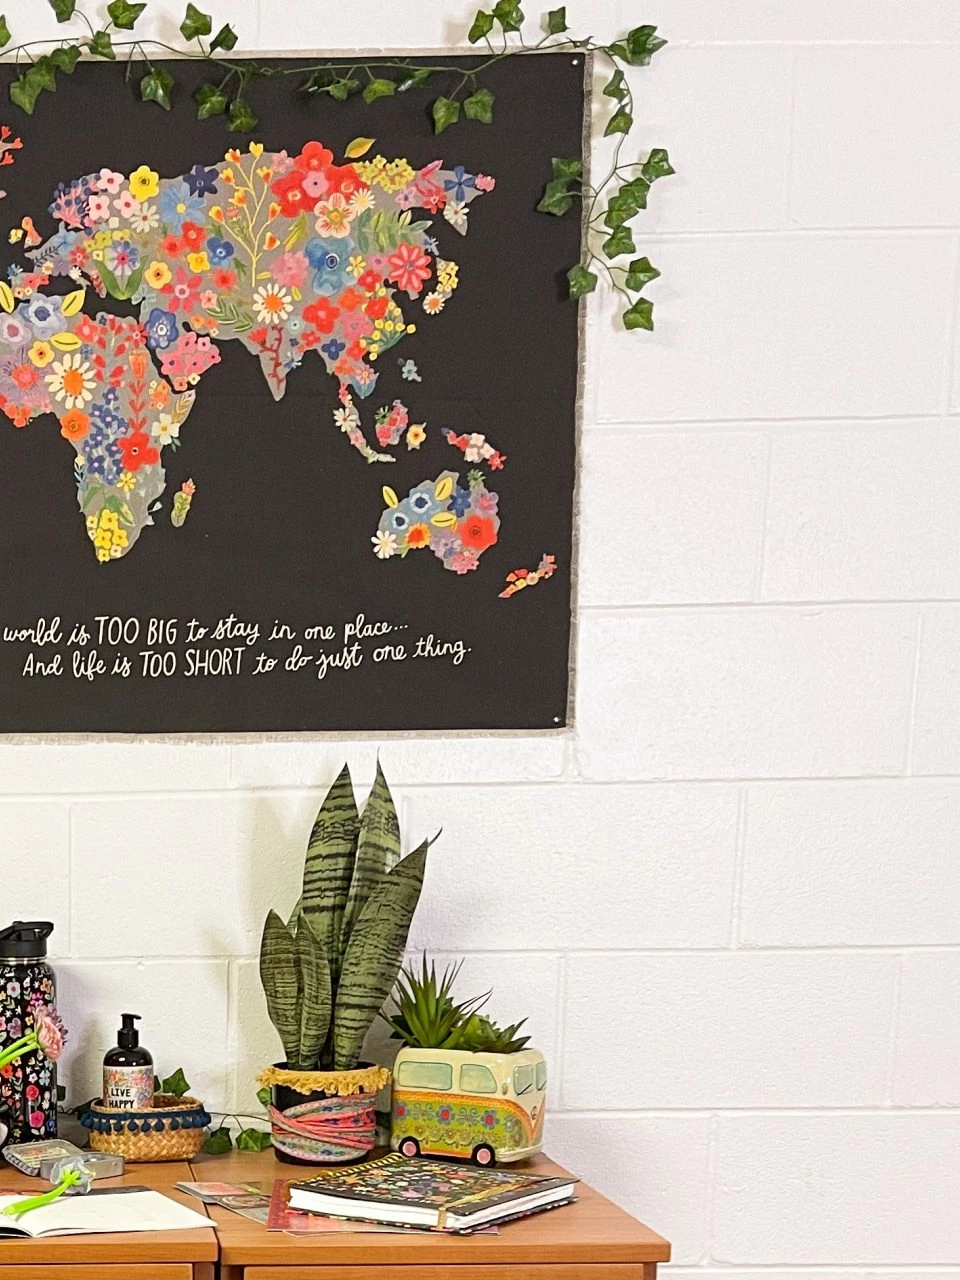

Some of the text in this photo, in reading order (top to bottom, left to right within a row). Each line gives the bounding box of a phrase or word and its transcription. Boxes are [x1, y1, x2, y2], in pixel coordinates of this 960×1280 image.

[3, 616, 63, 647] world
[66, 623, 91, 646] is
[94, 615, 140, 646] TOO
[147, 618, 178, 646] BIG
[185, 618, 209, 643] to
[209, 613, 261, 646] stay
[267, 619, 297, 641] in
[304, 625, 336, 640] one
[344, 613, 409, 645] place...
[22, 633, 472, 682] And life is TOO SHORT to do just one thing.
[111, 1088, 131, 1097] LIVE
[108, 1100, 135, 1109] HAPPY
